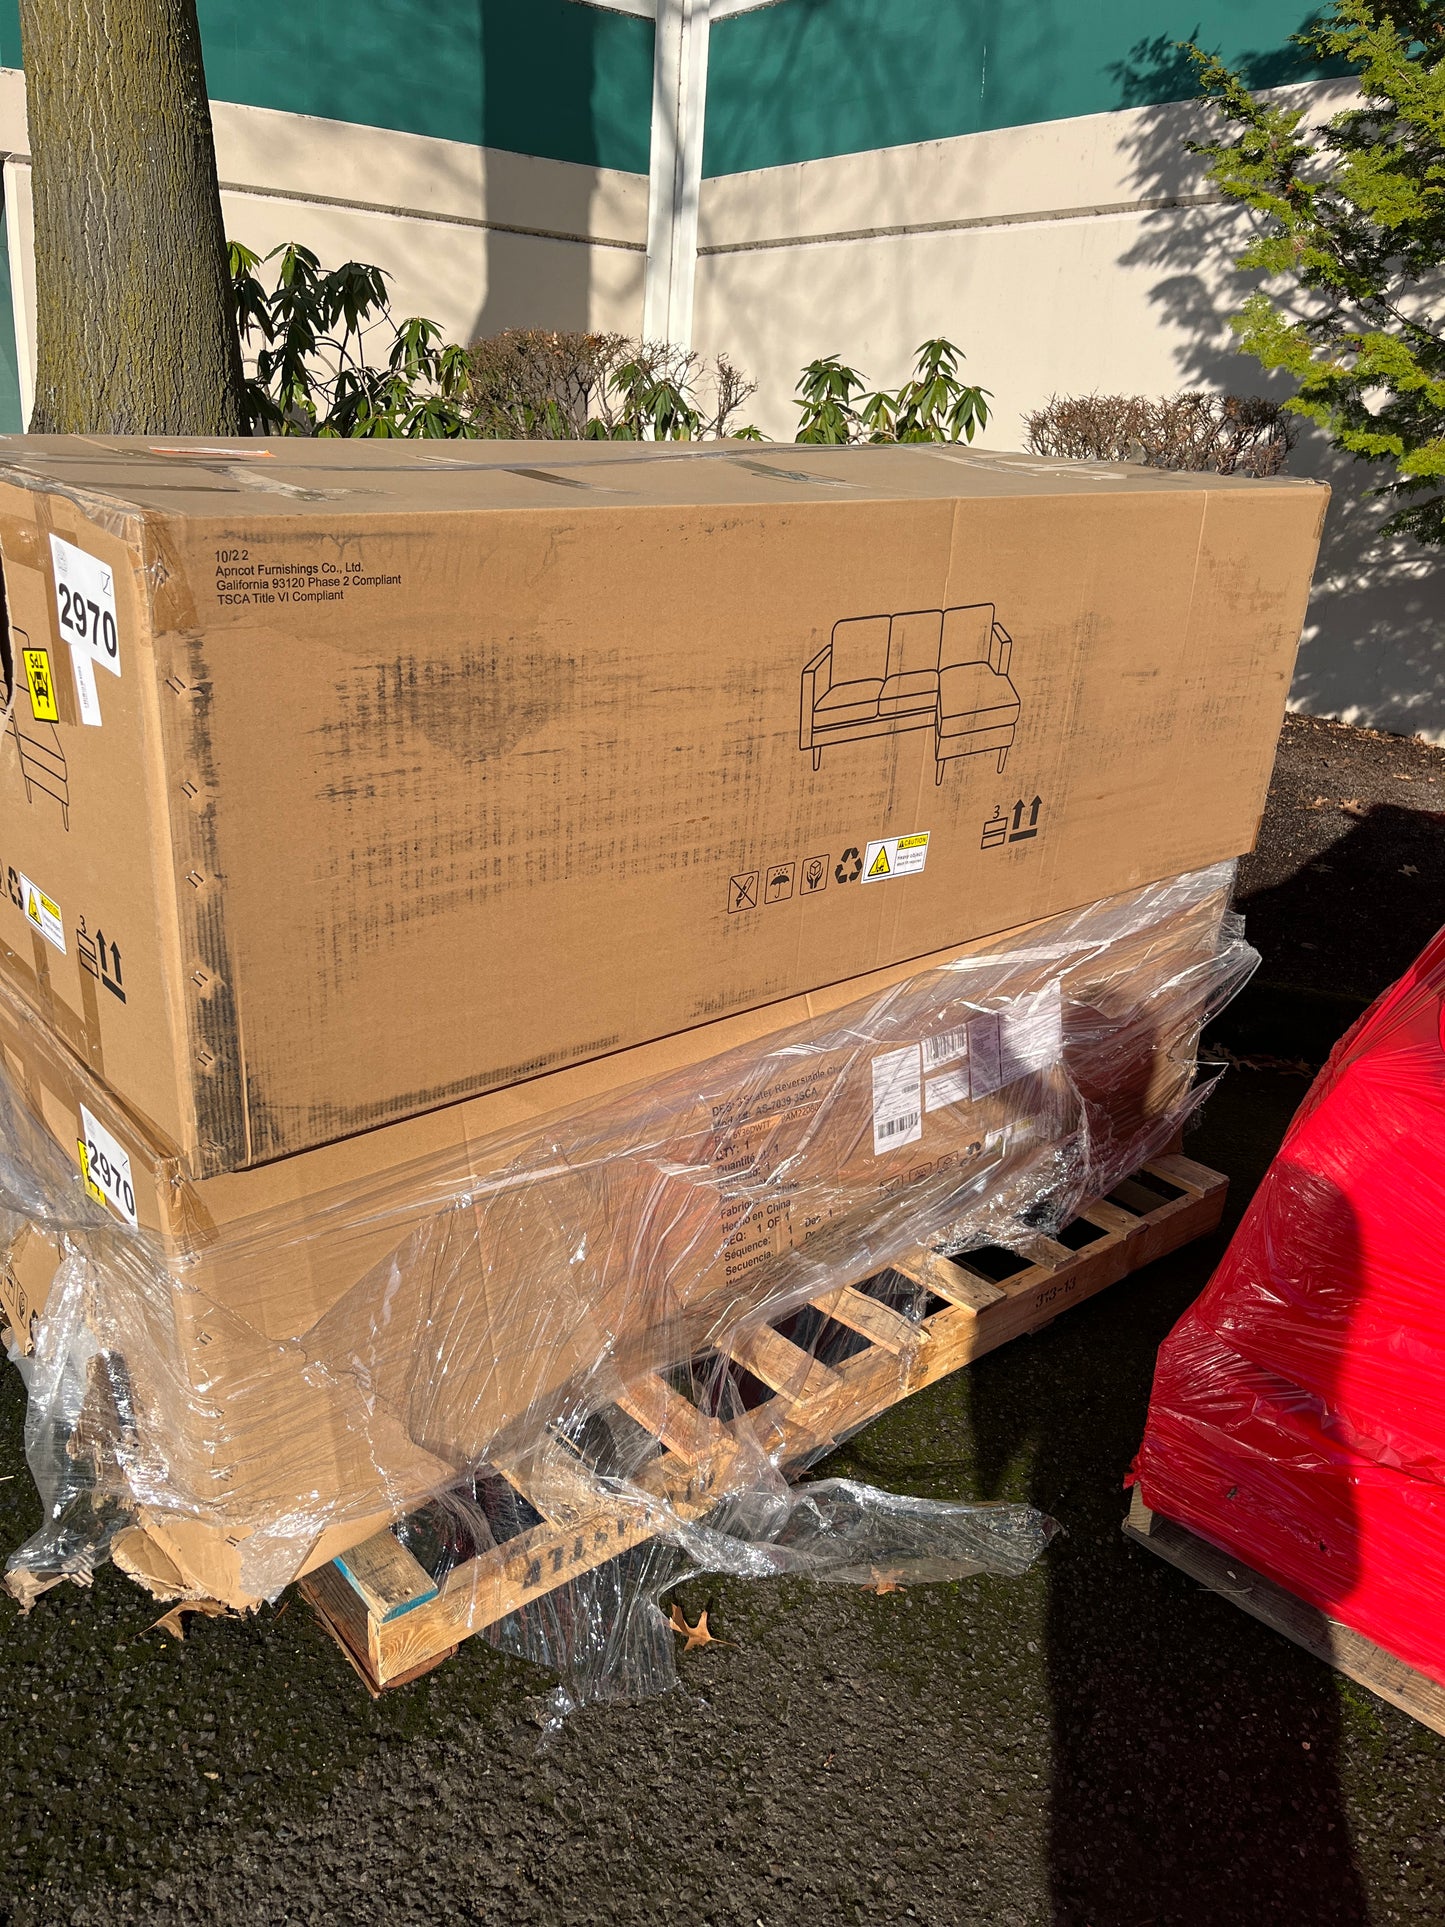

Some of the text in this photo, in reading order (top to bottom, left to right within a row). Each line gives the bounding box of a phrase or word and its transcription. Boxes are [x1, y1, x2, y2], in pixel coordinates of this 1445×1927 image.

[215, 561, 365, 579] Apricot Furnishings Co., Ltd.
[272, 577, 305, 589] 93120
[308, 577, 341, 588] Phase
[343, 576, 351, 586] 2
[352, 574, 402, 587] Compliant
[217, 590, 344, 605] TSCA Title VI Compliant
[58, 582, 117, 658] 2970
[992, 804, 1001, 819] 3
[87, 1139, 136, 1217] 2970
[752, 1210, 764, 1221] en
[766, 1199, 791, 1215] China
[756, 1223, 763, 1233] 1
[767, 1216, 780, 1229] OF
[784, 1211, 790, 1221] 1
[724, 1236, 771, 1262] Séquence:
[787, 1225, 793, 1234] 1
[788, 1239, 793, 1248] 1
